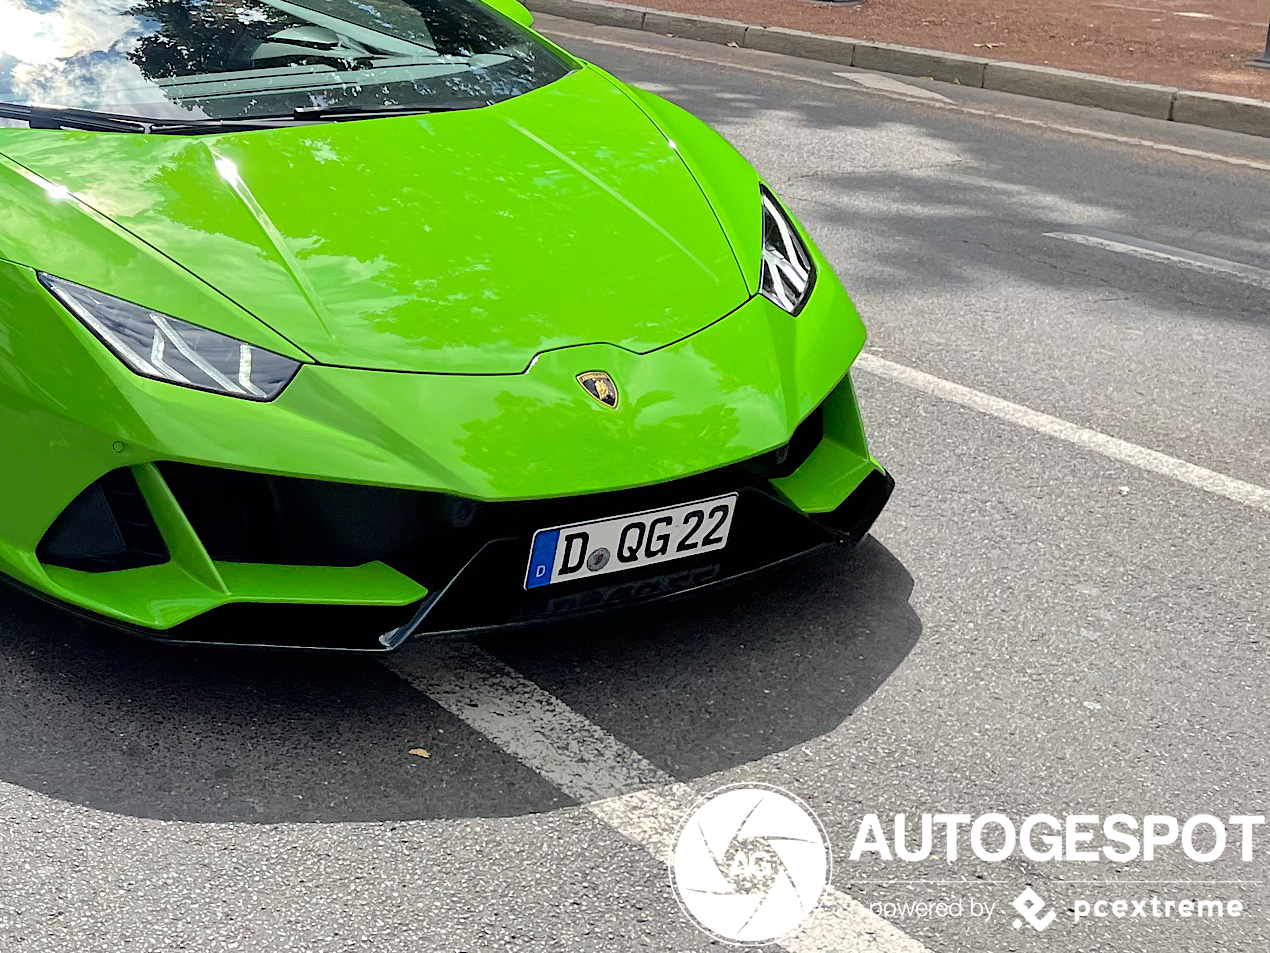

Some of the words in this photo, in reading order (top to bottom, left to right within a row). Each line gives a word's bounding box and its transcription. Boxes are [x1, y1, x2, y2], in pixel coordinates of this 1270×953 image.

[557, 531, 590, 576] D
[616, 515, 673, 564] QG
[675, 504, 730, 553] 22
